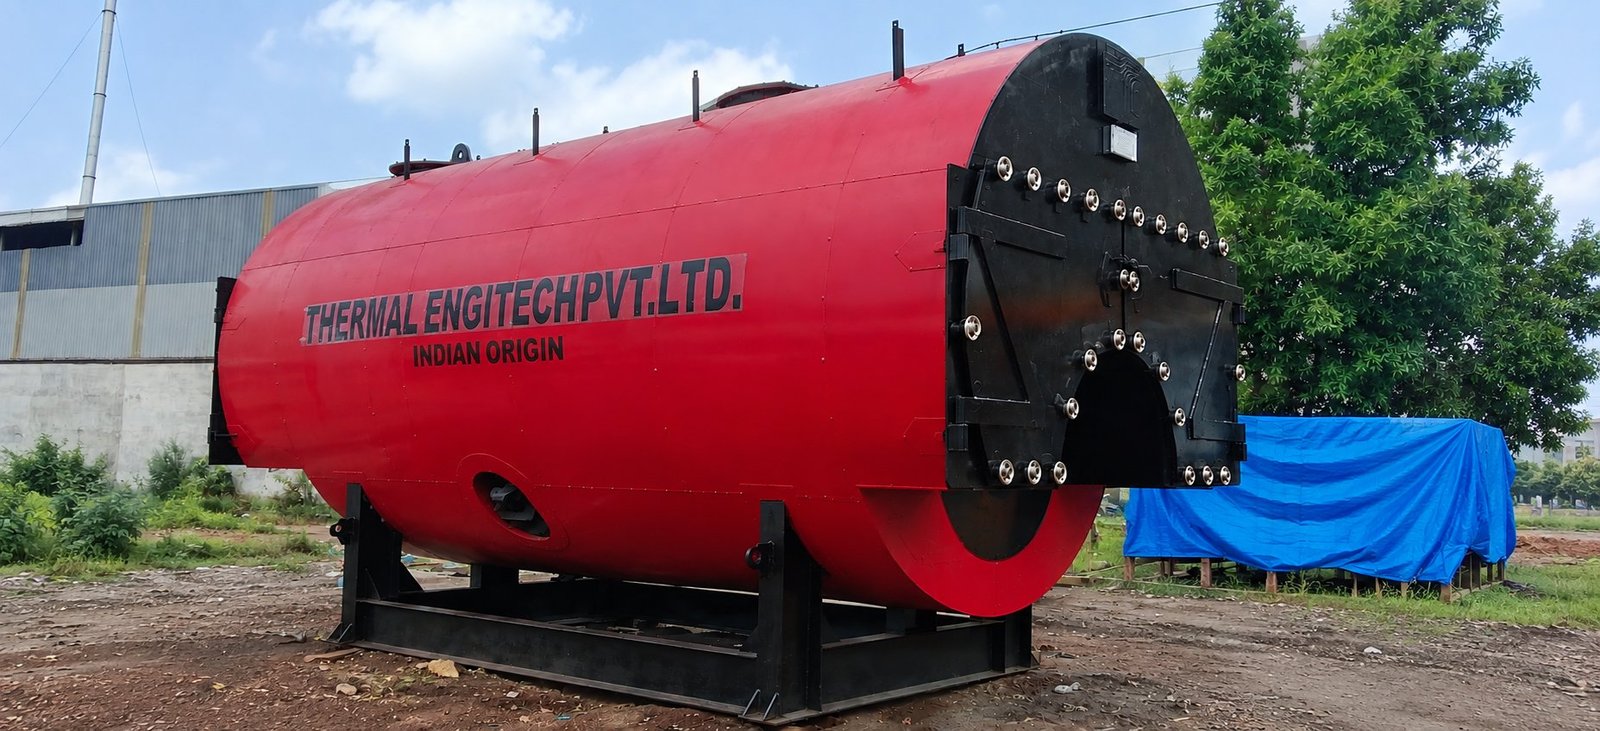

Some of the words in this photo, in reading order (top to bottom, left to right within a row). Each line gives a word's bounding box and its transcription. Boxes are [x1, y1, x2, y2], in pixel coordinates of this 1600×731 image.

[306, 293, 418, 345] THERMAL
[413, 341, 481, 368] INDIAN
[486, 335, 565, 364] ORIGIN
